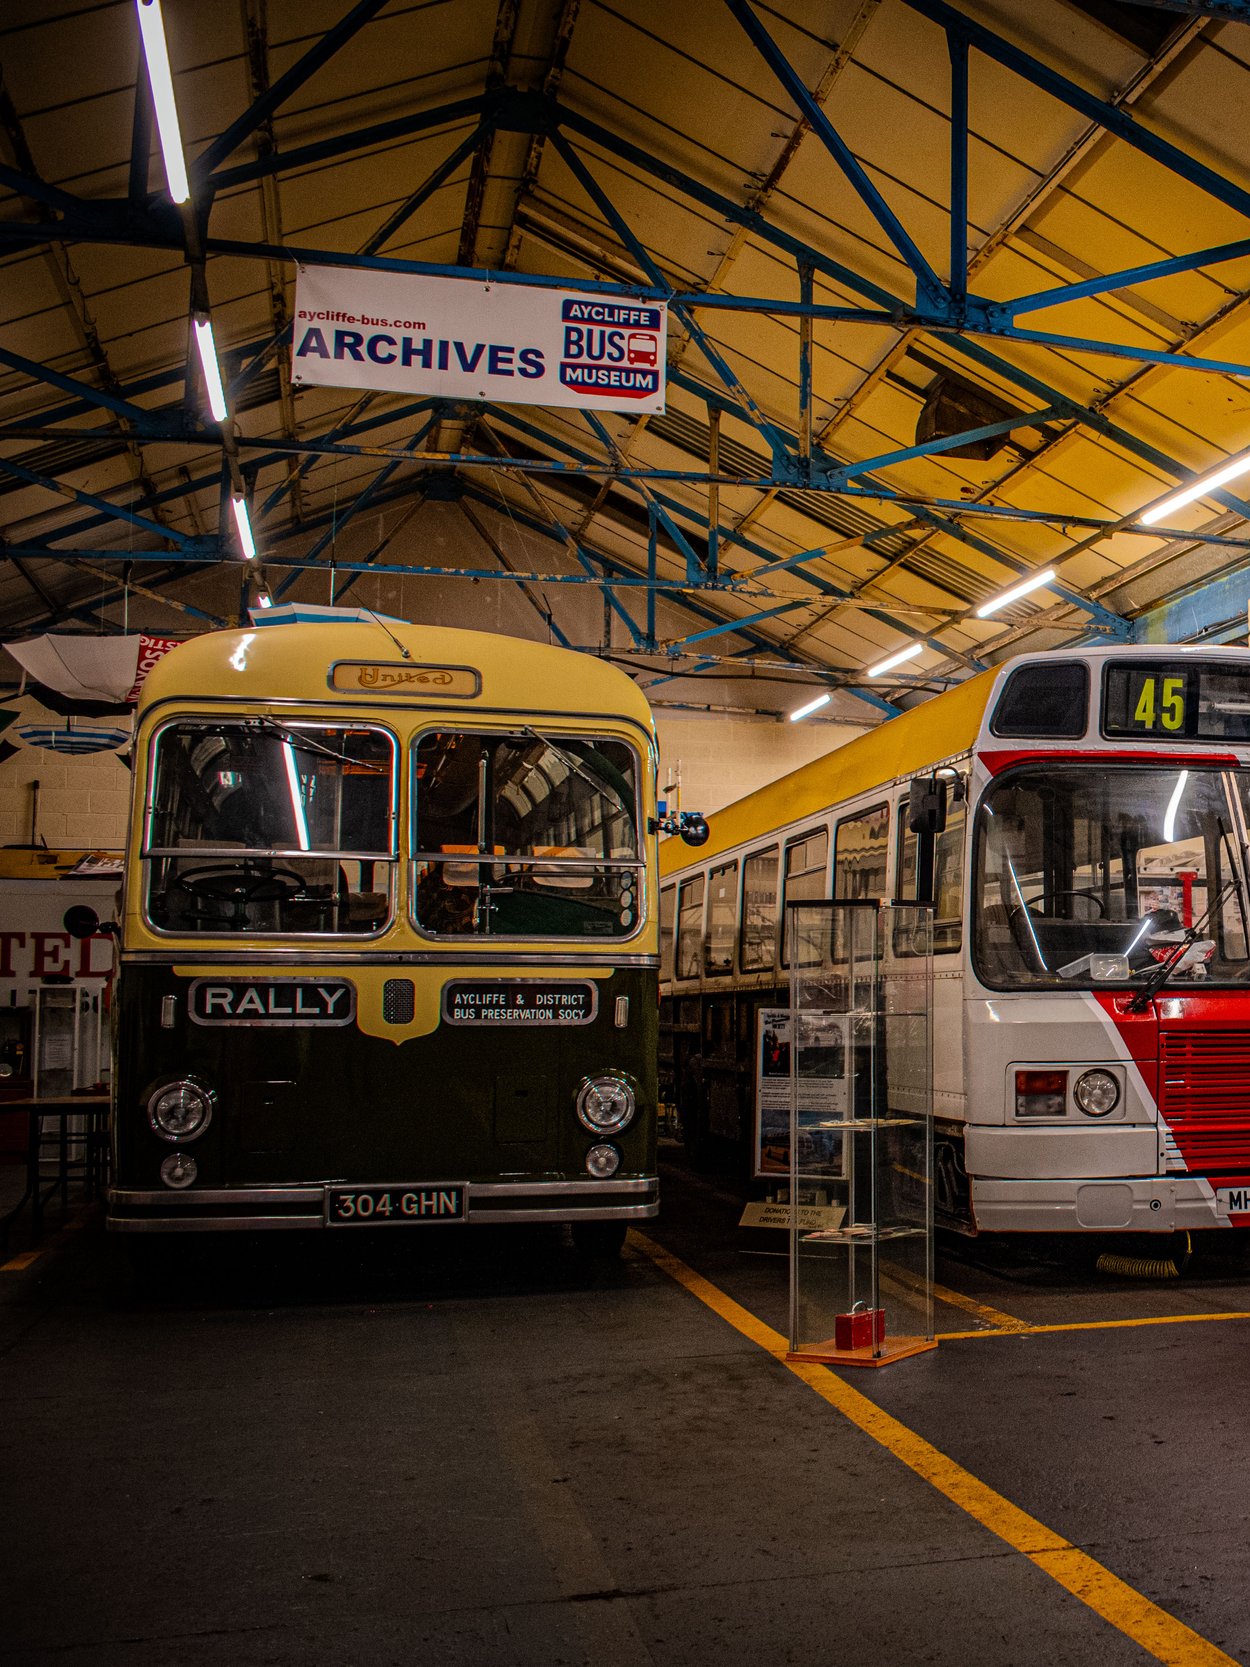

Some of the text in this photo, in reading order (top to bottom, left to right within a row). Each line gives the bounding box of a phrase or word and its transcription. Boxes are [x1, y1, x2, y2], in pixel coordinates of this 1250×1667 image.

[297, 309, 427, 331] aycliffe-bus.com
[569, 304, 651, 327] AYCLIFFE
[295, 326, 547, 380] ARCHIVES
[563, 326, 626, 363] BUS
[565, 369, 654, 390] MUSEUM
[357, 666, 453, 690] United
[1134, 677, 1185, 731] 45
[204, 987, 347, 1015] RALLY
[453, 993, 586, 1006] AYCLIFFE & DISTRICT
[454, 1008, 586, 1021] BUS PRESERVATION SOCY
[336, 1191, 458, 1218] 304 GHN
